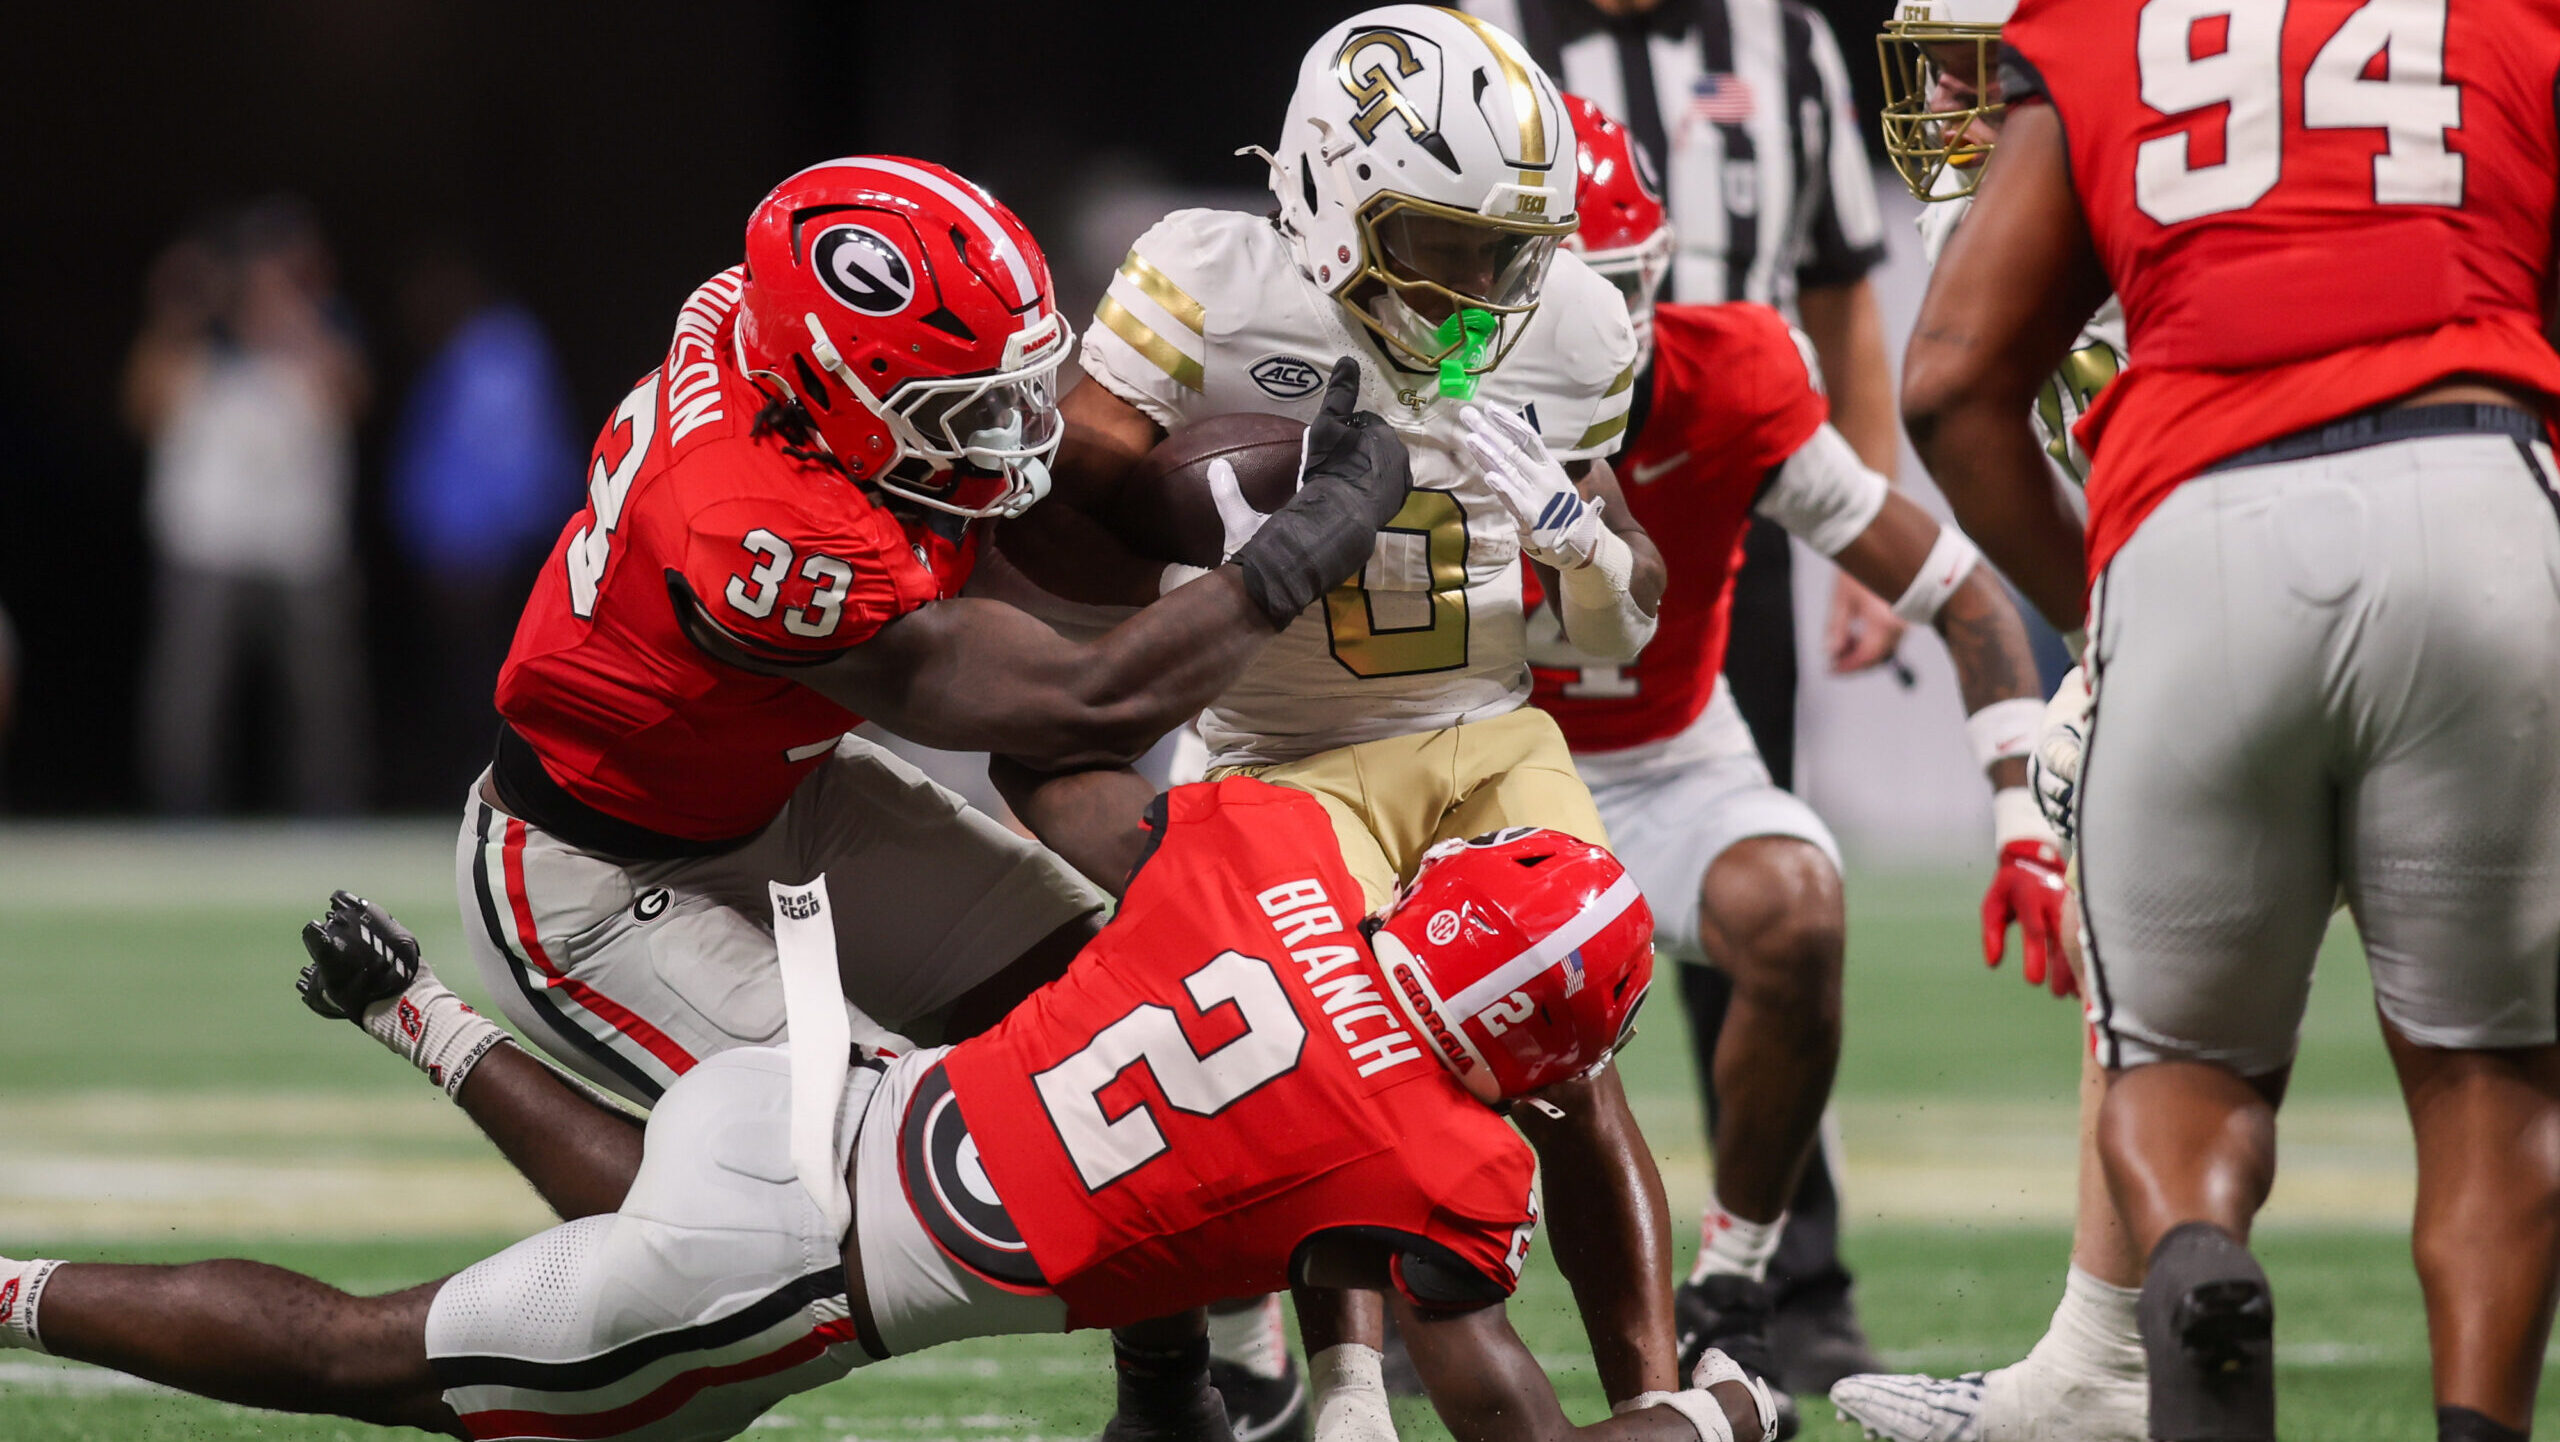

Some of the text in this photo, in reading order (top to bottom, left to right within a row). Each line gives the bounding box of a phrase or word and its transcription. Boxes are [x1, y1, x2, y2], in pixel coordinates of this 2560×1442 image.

[1337, 30, 1430, 147] GT
[2135, 0, 2467, 228] 94
[1260, 365, 1310, 385] ACC
[1397, 388, 1428, 411] GT
[724, 526, 856, 638] 33
[1256, 877, 1422, 1080] BRANCH
[1429, 913, 1457, 942] SEC
[1393, 962, 1475, 1076] GEORGIA
[1477, 990, 1535, 1038] 2
[1030, 948, 1309, 1195] 2
